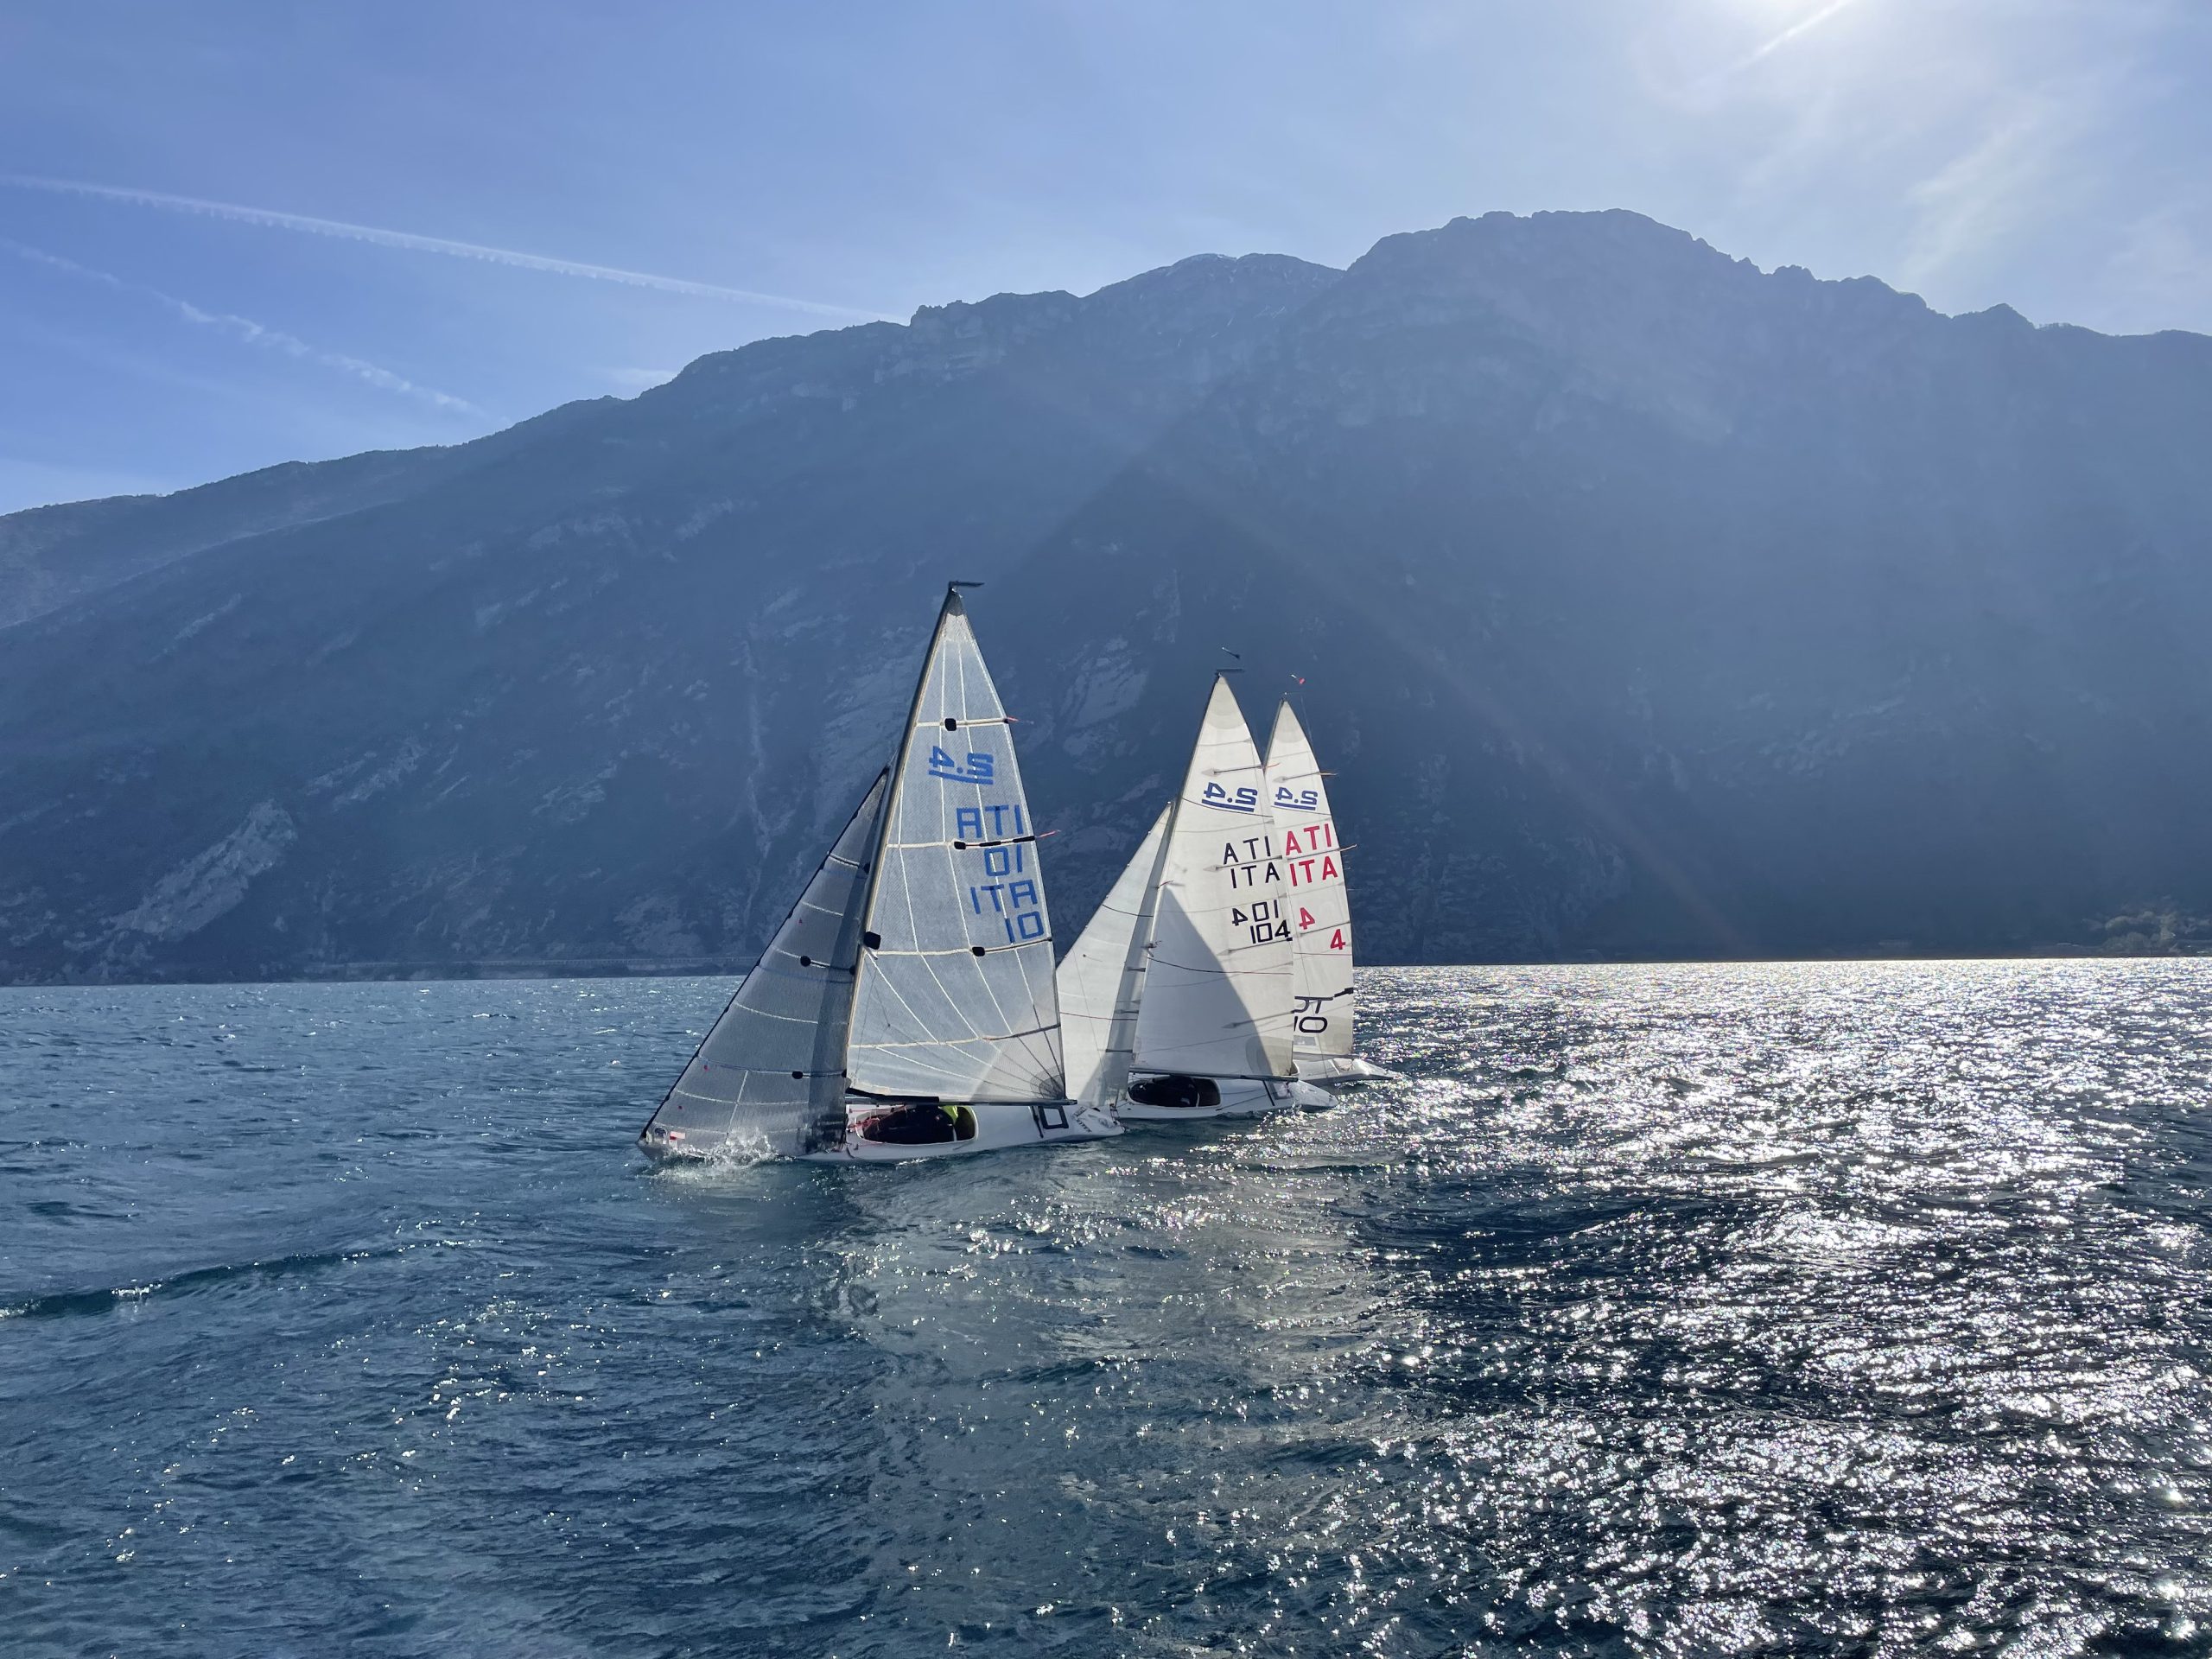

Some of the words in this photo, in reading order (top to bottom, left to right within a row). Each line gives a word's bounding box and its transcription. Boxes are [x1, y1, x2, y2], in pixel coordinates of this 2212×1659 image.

[1230, 861, 1281, 889] ITA
[1289, 855, 1338, 887] ITA
[969, 879, 1038, 914] ITA
[1004, 911, 1045, 943] 10
[1250, 919, 1291, 944] 104
[1330, 928, 1346, 950] 4
